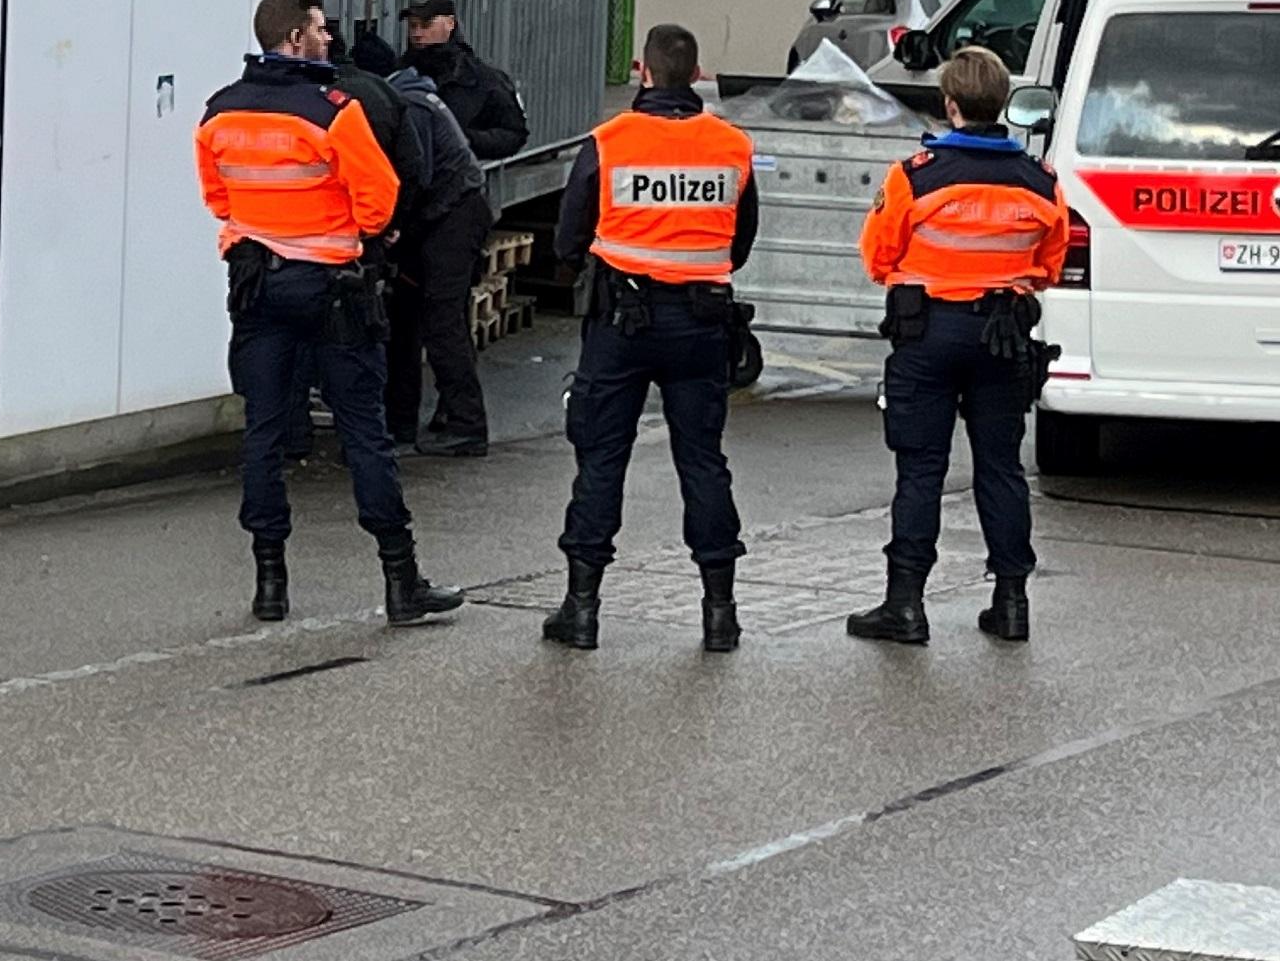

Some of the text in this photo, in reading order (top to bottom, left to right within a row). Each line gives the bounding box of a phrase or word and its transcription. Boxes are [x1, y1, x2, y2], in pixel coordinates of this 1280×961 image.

[632, 173, 725, 202] Polizei
[1134, 188, 1259, 215] POLIZEI
[1236, 245, 1261, 265] ZH
